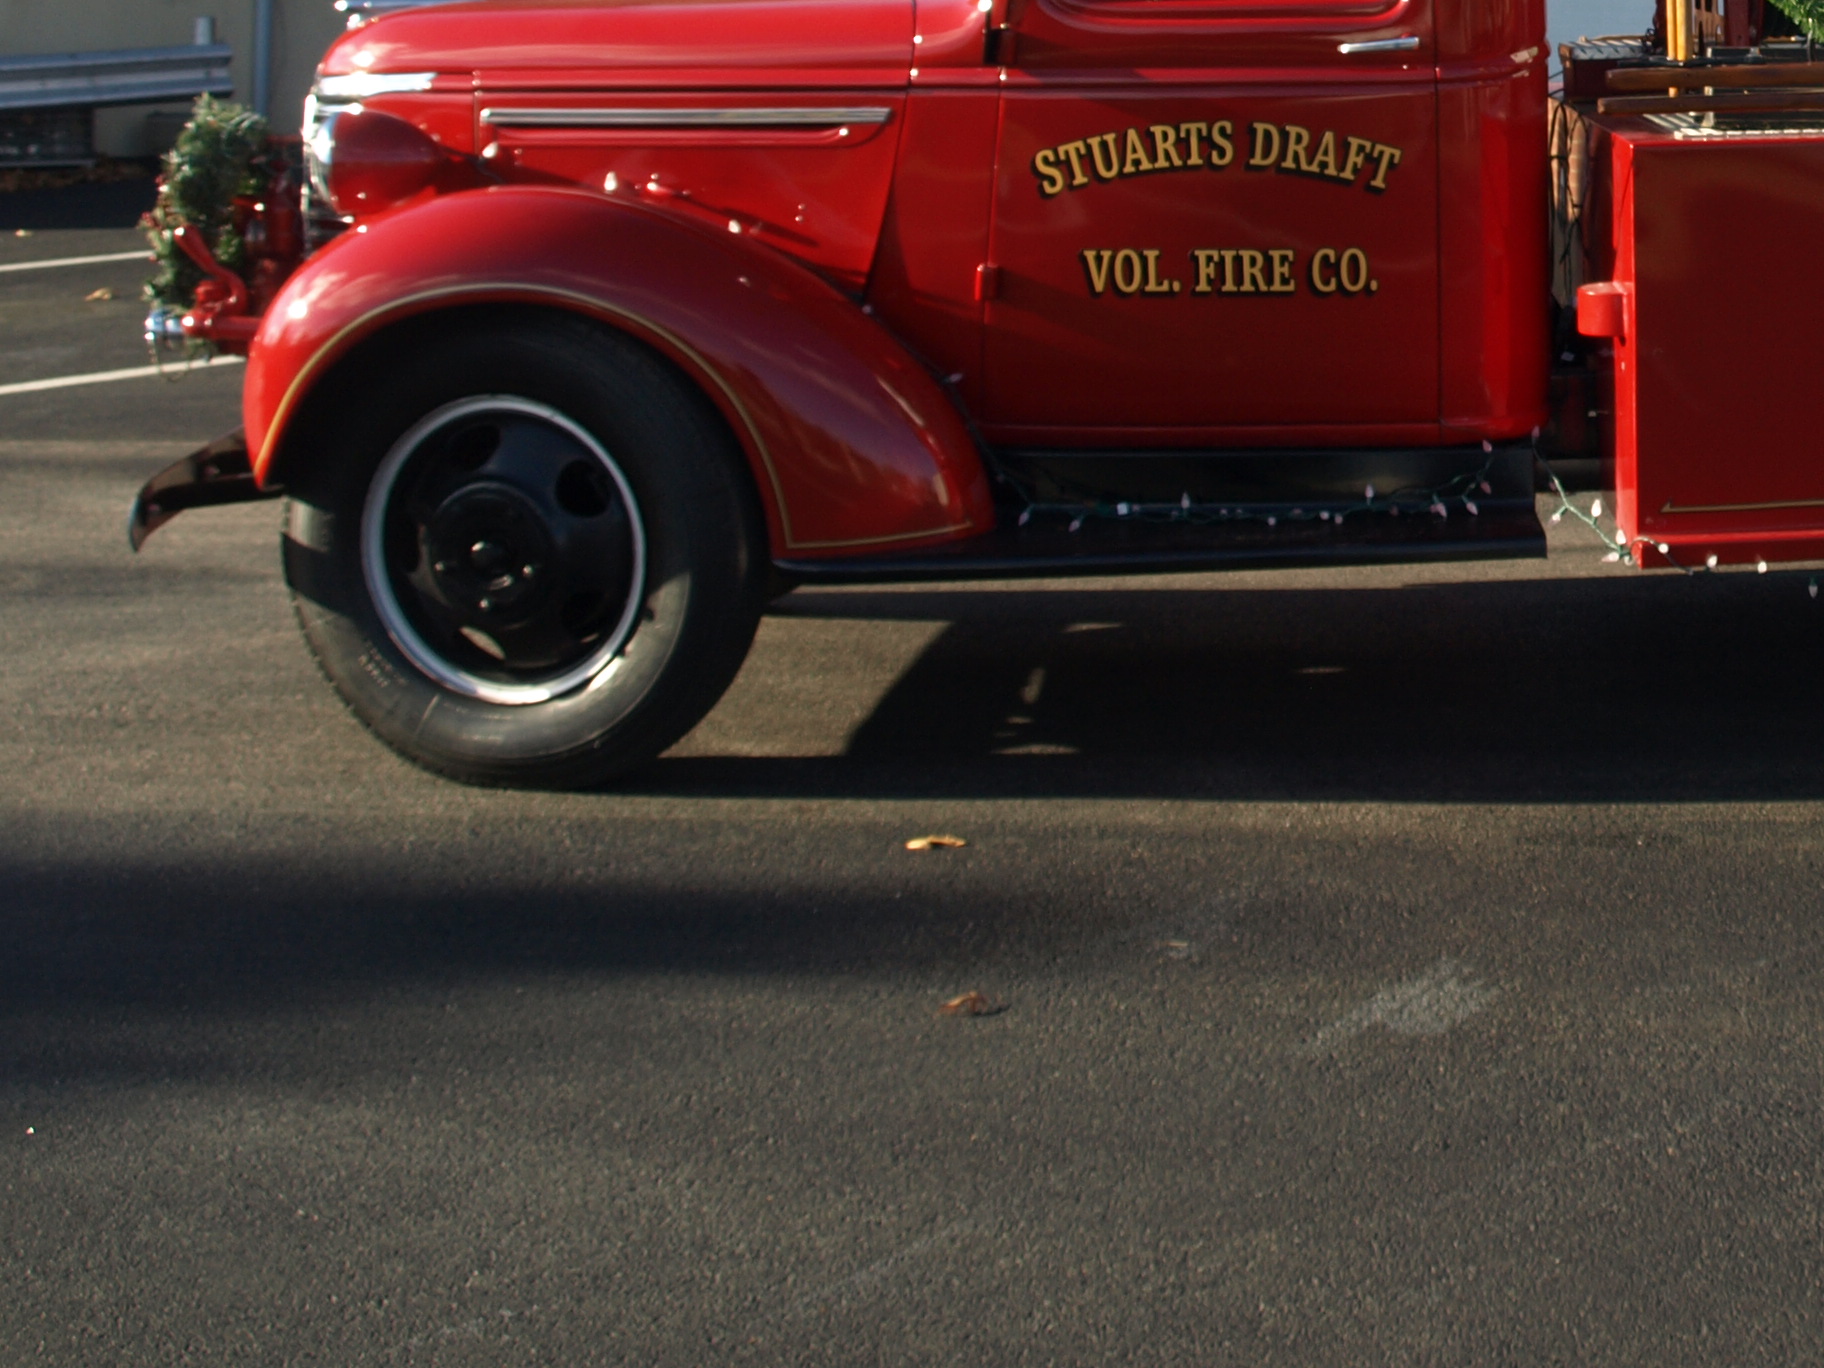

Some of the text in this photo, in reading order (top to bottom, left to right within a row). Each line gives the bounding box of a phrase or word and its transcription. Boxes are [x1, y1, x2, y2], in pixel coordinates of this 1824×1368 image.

[1033, 120, 1402, 196] STUARTS DRAFT
[1082, 247, 1379, 295] VOL. FIRE CO.
